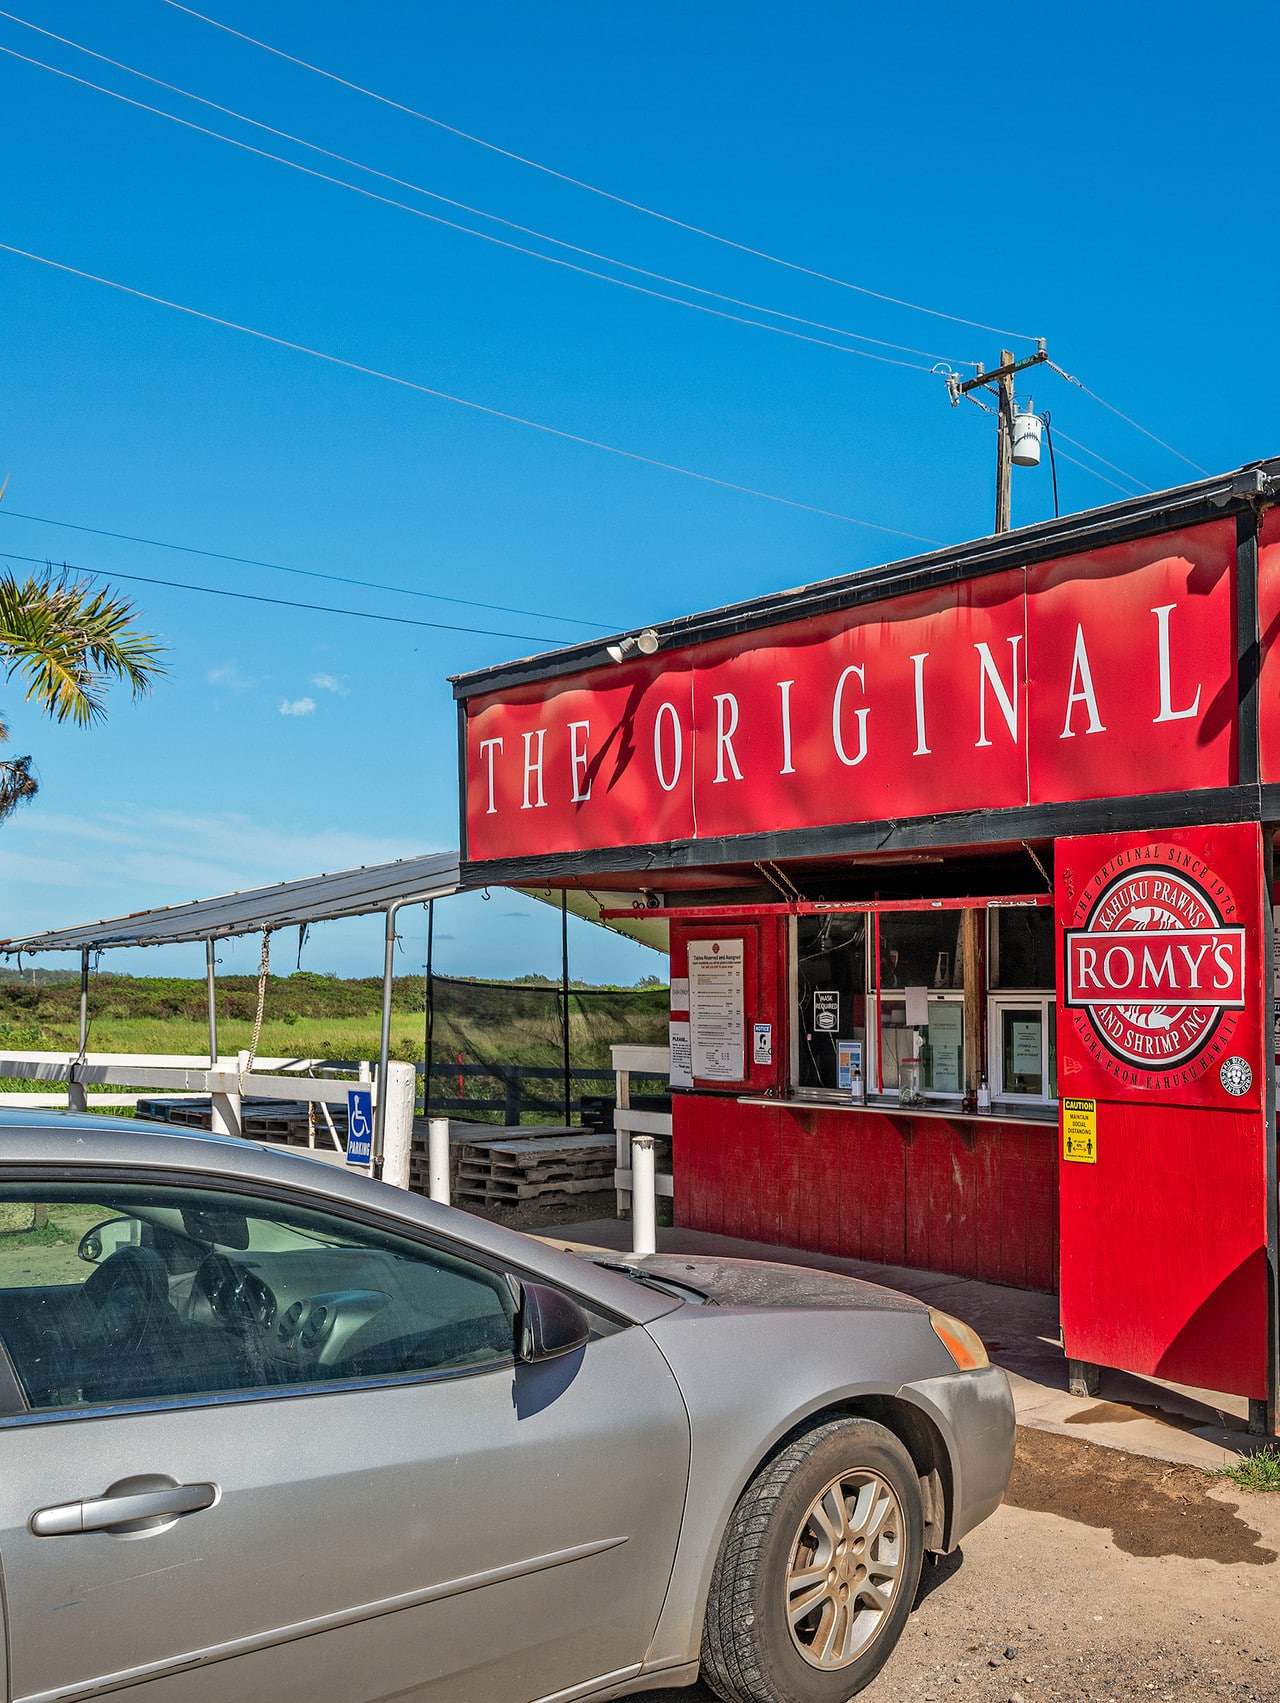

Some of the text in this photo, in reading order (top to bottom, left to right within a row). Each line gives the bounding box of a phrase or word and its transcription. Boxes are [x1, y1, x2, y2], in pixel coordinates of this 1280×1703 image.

[479, 603, 1202, 815] THE ORIGINAL
[1073, 846, 1235, 921] THE ORIGINAL SINCE 1978
[1099, 880, 1207, 930] KAHUKU PRAWNS
[1076, 936, 1234, 989] ROMY'S
[1074, 1015, 1102, 1060] ALOHA
[1105, 1061, 1138, 1086] FROM
[1146, 1068, 1197, 1090] KAHUKU
[1200, 1017, 1238, 1071] HAWAII
[1098, 1006, 1207, 1055] AND SHRIMP INC
[1065, 1100, 1094, 1111] CAUTION
[1072, 1120, 1087, 1128] SOCIAL
[349, 1141, 370, 1156] PARKING
